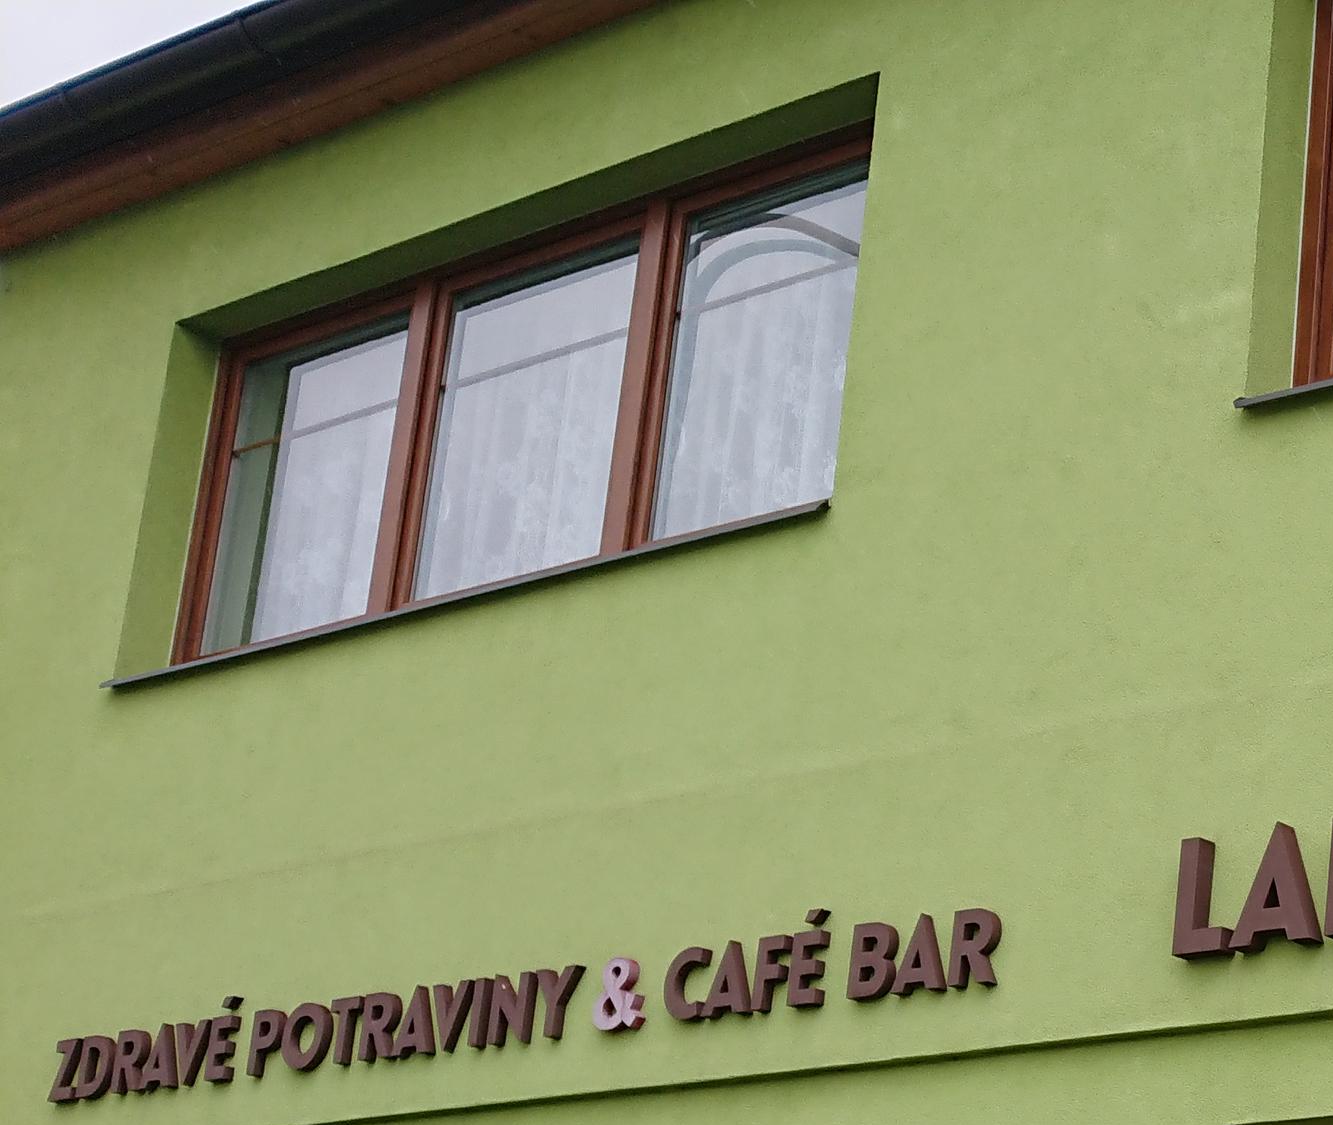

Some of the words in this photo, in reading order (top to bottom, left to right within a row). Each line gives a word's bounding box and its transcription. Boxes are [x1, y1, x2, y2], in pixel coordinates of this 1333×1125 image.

[47, 996, 244, 1103] ZDRAVÉ
[245, 964, 587, 1080] POTRAVINY
[592, 957, 645, 1033] &
[663, 907, 832, 1024] CAFÉ
[845, 907, 1003, 1004] BAR
